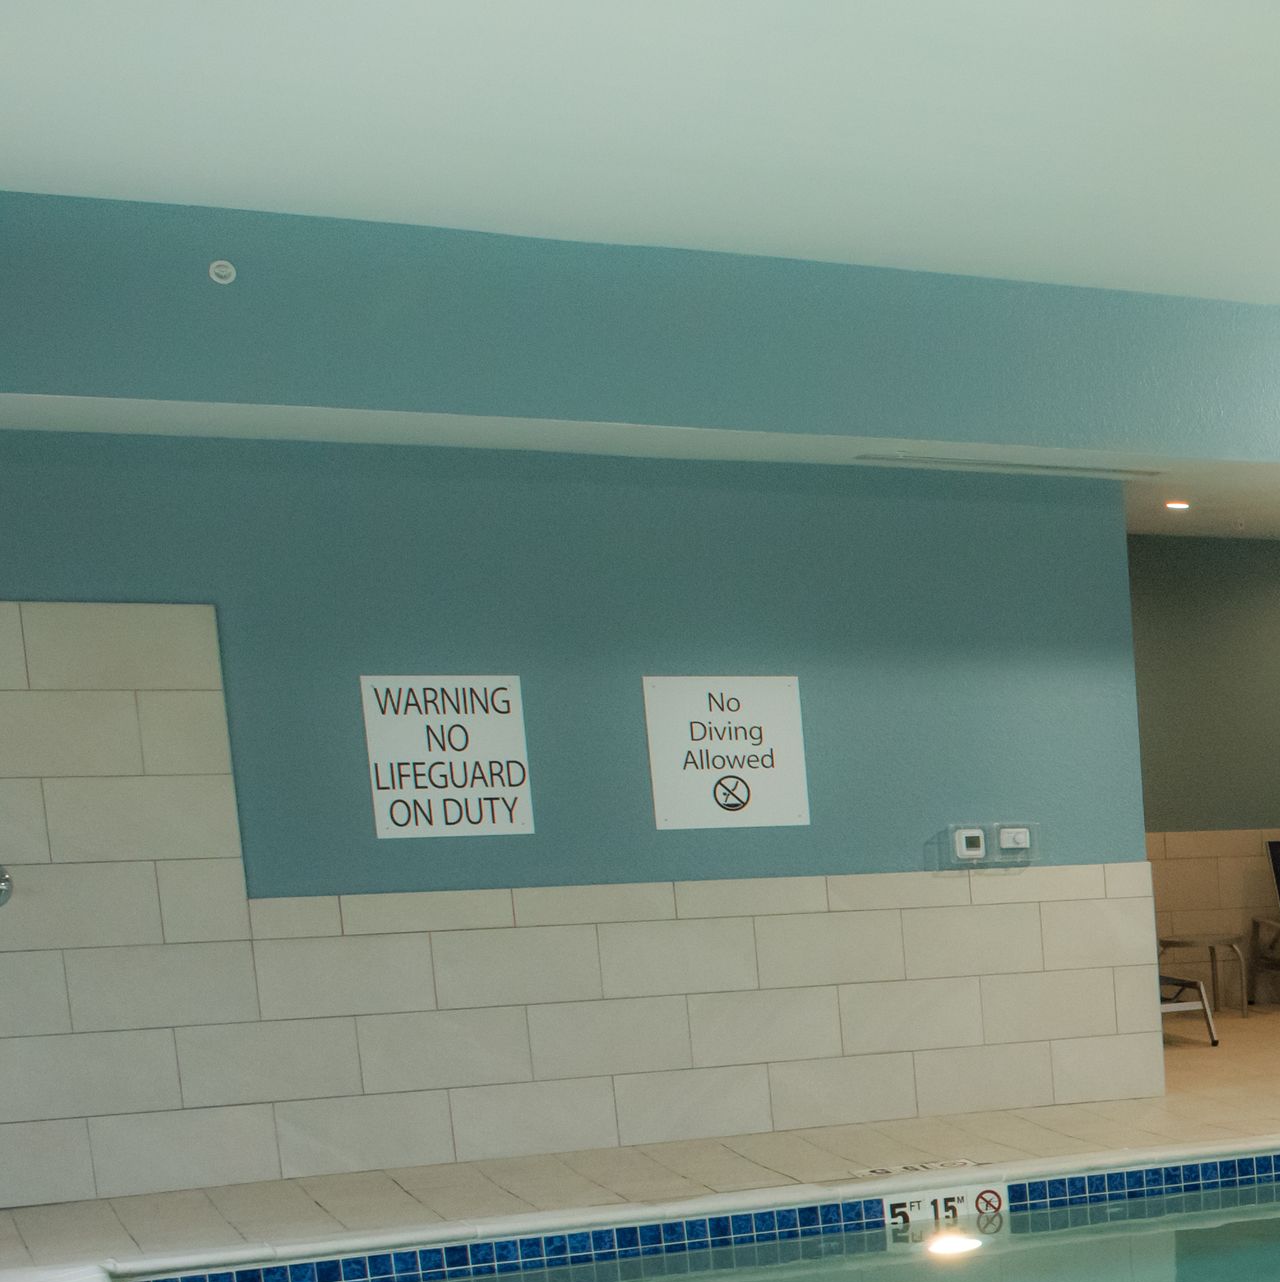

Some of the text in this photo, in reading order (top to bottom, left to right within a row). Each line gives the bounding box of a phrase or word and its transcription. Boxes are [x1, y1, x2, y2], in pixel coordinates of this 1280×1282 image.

[374, 687, 511, 715] WARNING
[708, 691, 741, 712] No
[426, 724, 469, 752] NO
[690, 721, 764, 746] Diving
[683, 748, 775, 770] Allowed
[374, 760, 526, 790] LIFEGUARD
[389, 797, 518, 827] ON DUTY
[890, 1202, 910, 1224] 5
[909, 1200, 922, 1211] FT
